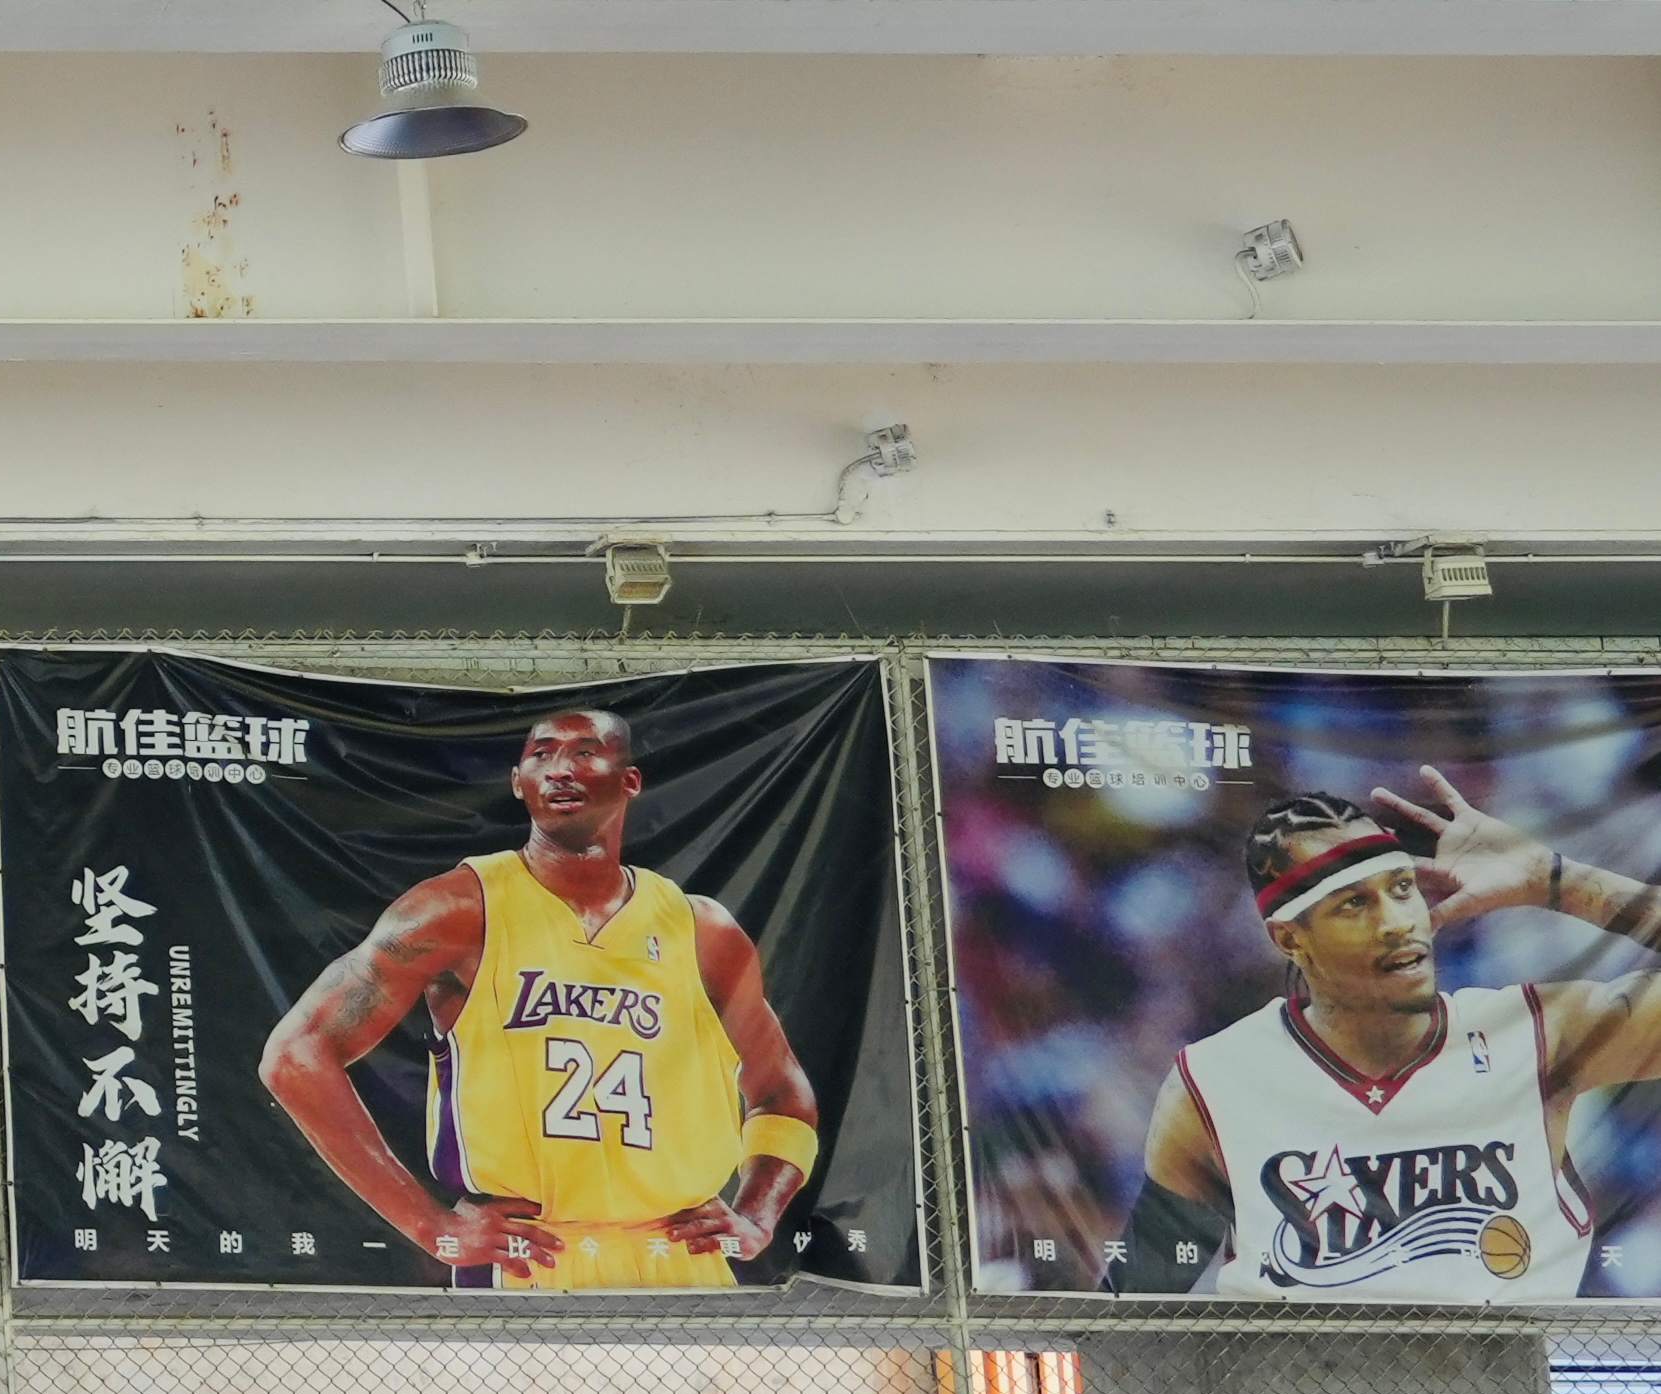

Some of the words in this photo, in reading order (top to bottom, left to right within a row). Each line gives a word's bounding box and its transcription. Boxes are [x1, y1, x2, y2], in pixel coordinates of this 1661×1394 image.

[56, 708, 310, 764] 航佳篮球
[995, 717, 1252, 770] 航佳篮球
[102, 758, 266, 784] 专业篮球培训中心
[1043, 767, 1209, 789] 专业篮球培训中心
[503, 970, 661, 1038] LAKERS
[69, 865, 168, 1221] 坚持不懈
[169, 946, 199, 1142] UNREMITTINGLY
[542, 1037, 653, 1150] 24
